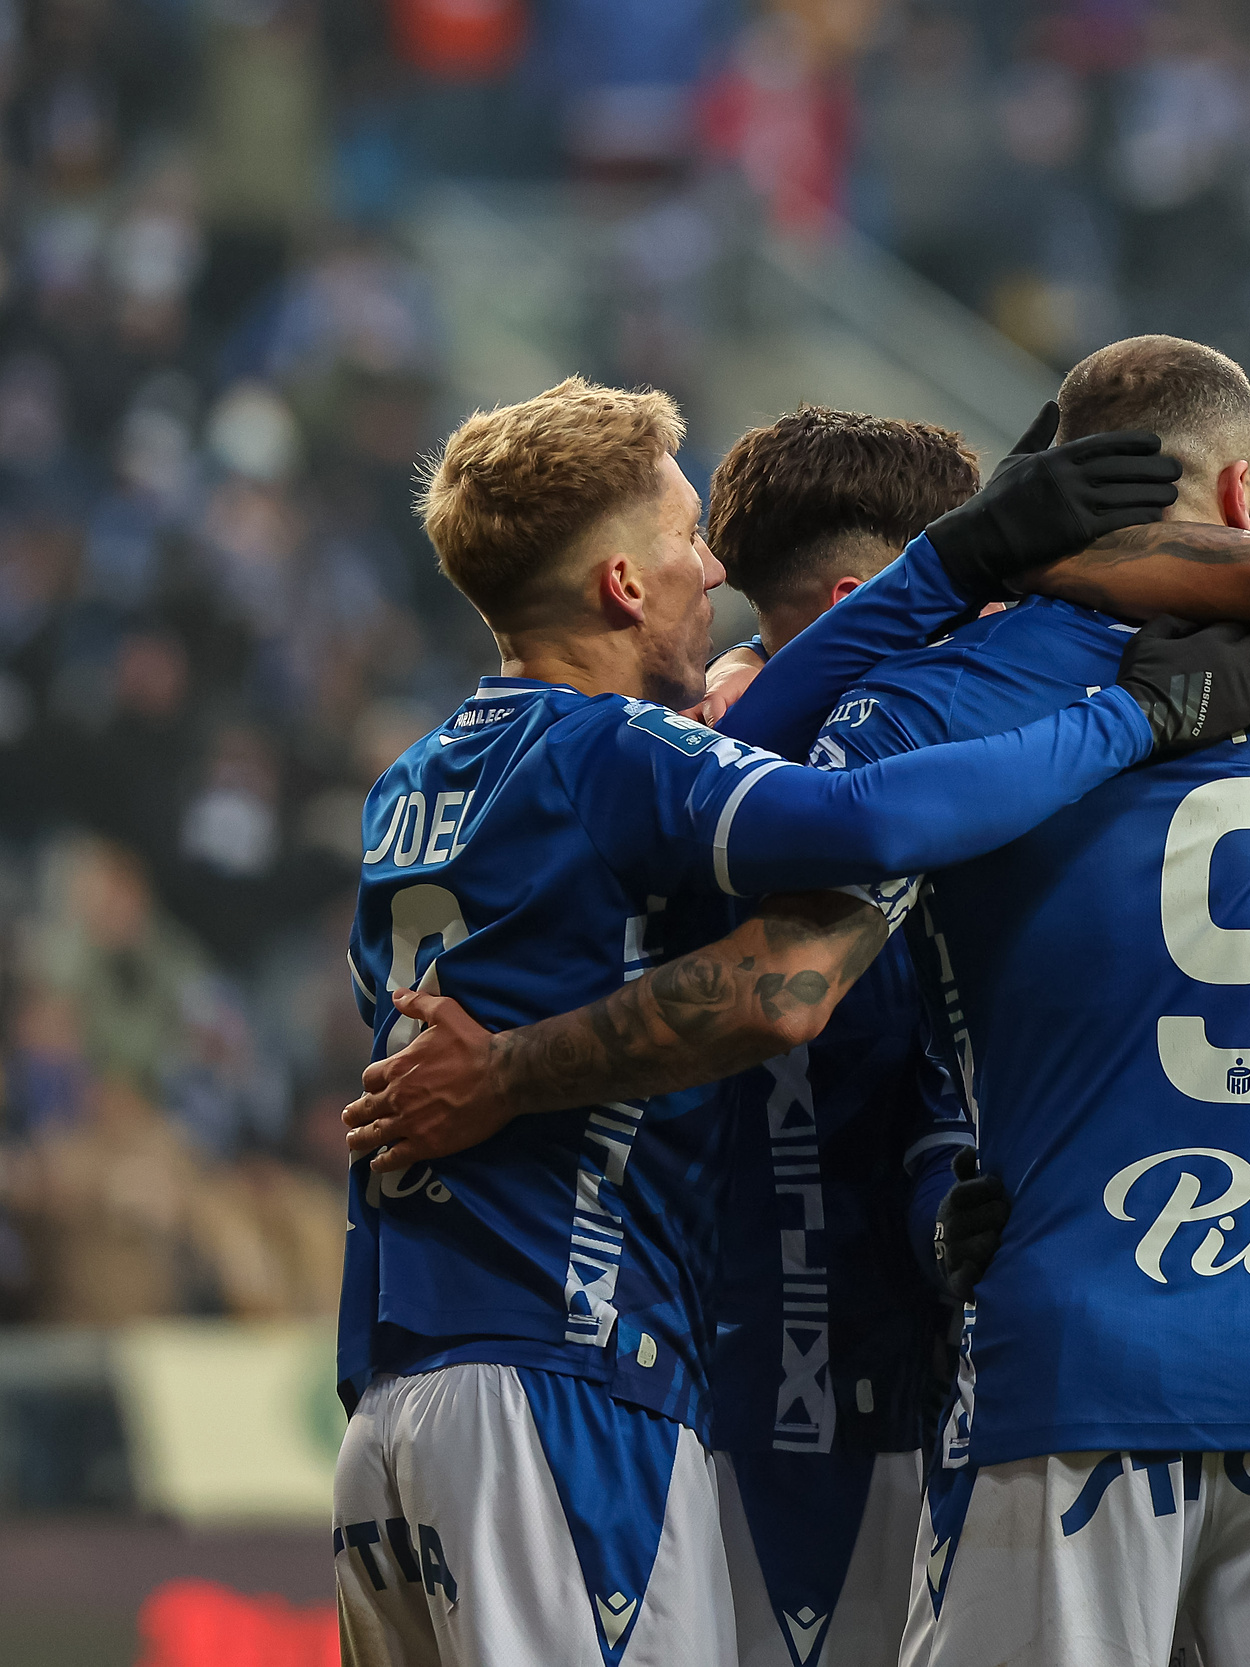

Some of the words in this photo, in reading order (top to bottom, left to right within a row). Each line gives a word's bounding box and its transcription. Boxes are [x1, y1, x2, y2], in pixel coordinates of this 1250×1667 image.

[821, 698, 880, 730] ury
[1197, 671, 1213, 729] PROSKARY
[363, 790, 475, 867] JOEL
